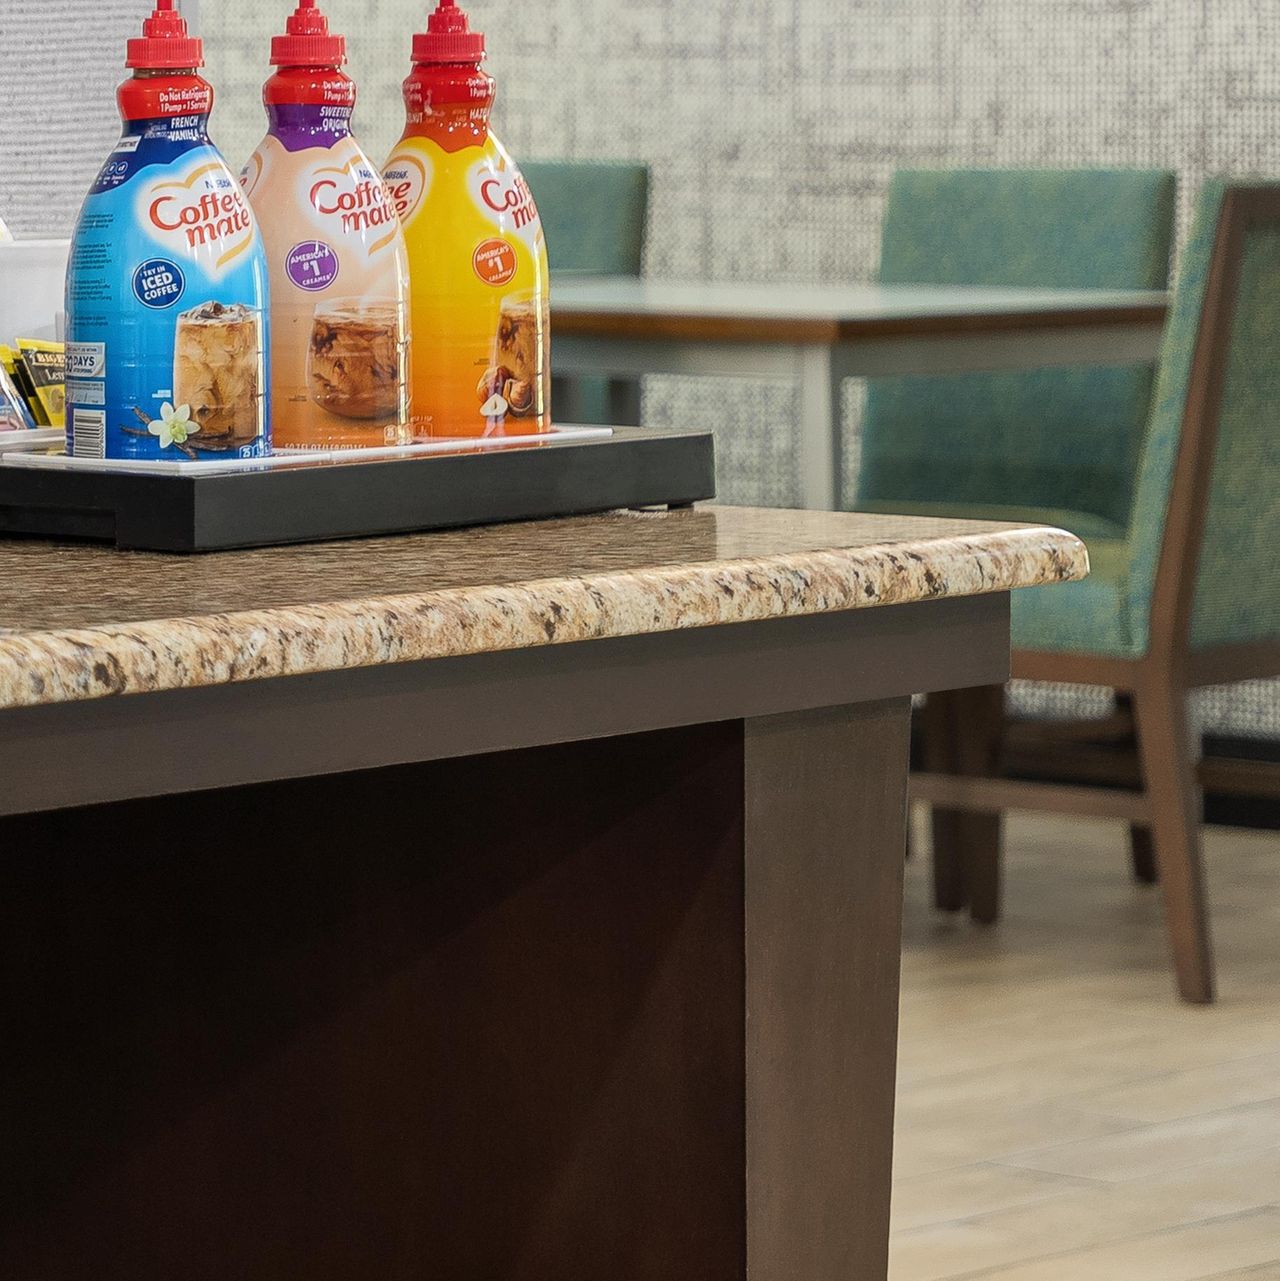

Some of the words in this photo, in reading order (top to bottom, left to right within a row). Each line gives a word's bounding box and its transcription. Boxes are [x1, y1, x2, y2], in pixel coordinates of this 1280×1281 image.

[182, 89, 209, 101] Refrigera
[171, 116, 199, 129] FRENCH
[149, 192, 242, 231] Coffee
[186, 208, 250, 247] mate
[142, 272, 173, 291] ICED
[144, 283, 179, 300] COFFEE
[36, 352, 65, 363] BIGE
[74, 355, 95, 367] DAYS
